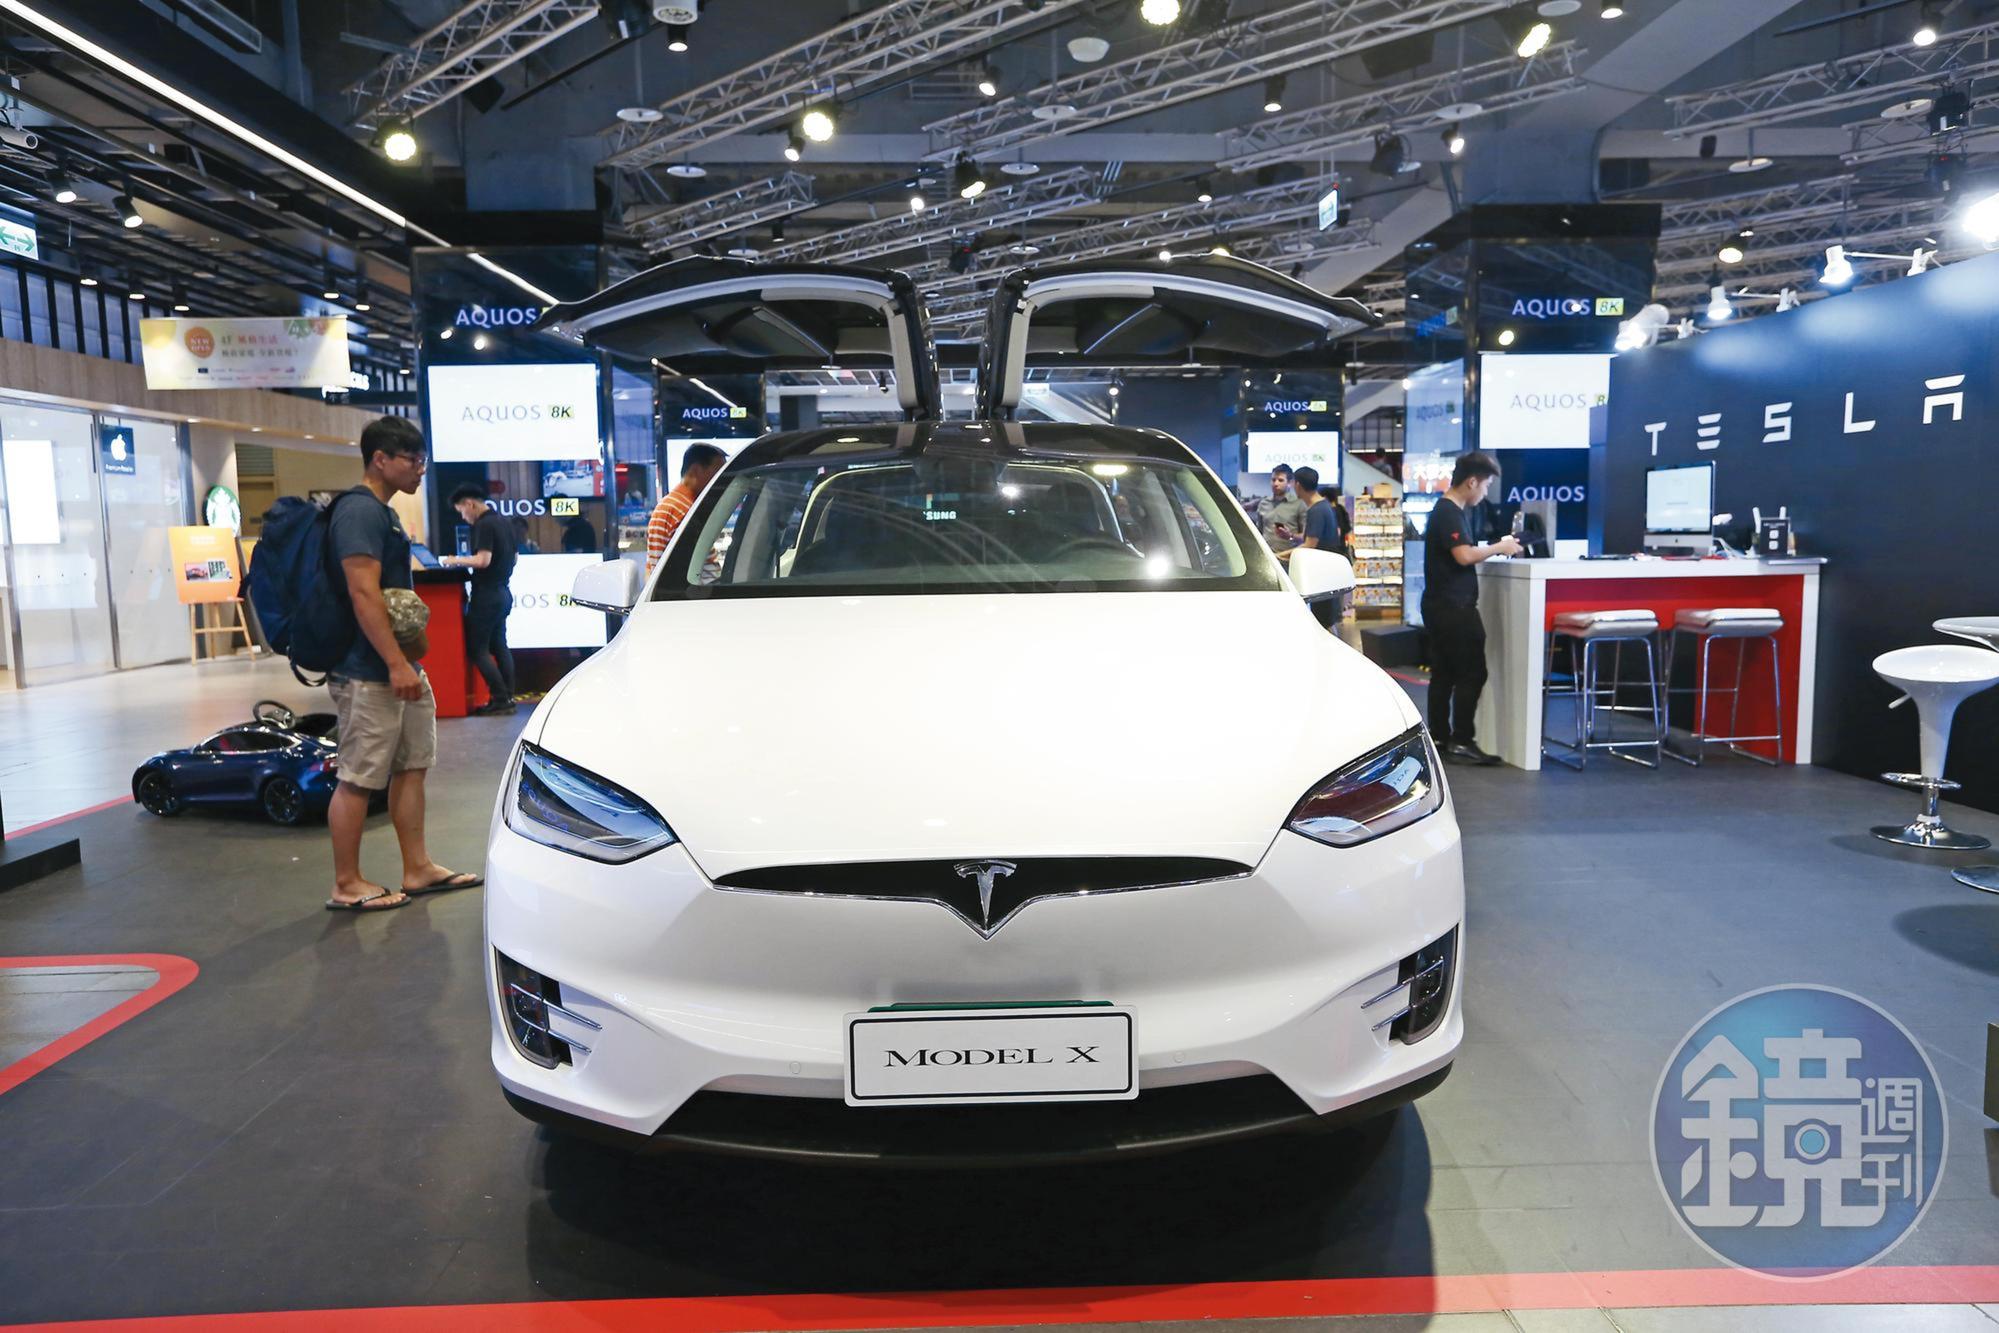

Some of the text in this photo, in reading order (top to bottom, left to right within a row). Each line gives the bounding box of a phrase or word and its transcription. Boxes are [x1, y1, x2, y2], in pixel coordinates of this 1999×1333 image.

[456, 308, 537, 328] AQUOS
[1512, 299, 1591, 319] AQUOS
[1264, 401, 1308, 413] AQUOS
[1510, 394, 1587, 412] AQUOS
[462, 405, 541, 425] AQUOS
[682, 407, 728, 420] AQUOS
[1644, 374, 1966, 456] TESLA
[923, 511, 957, 521] SUNG
[884, 1045, 1101, 1068] MODEL X
